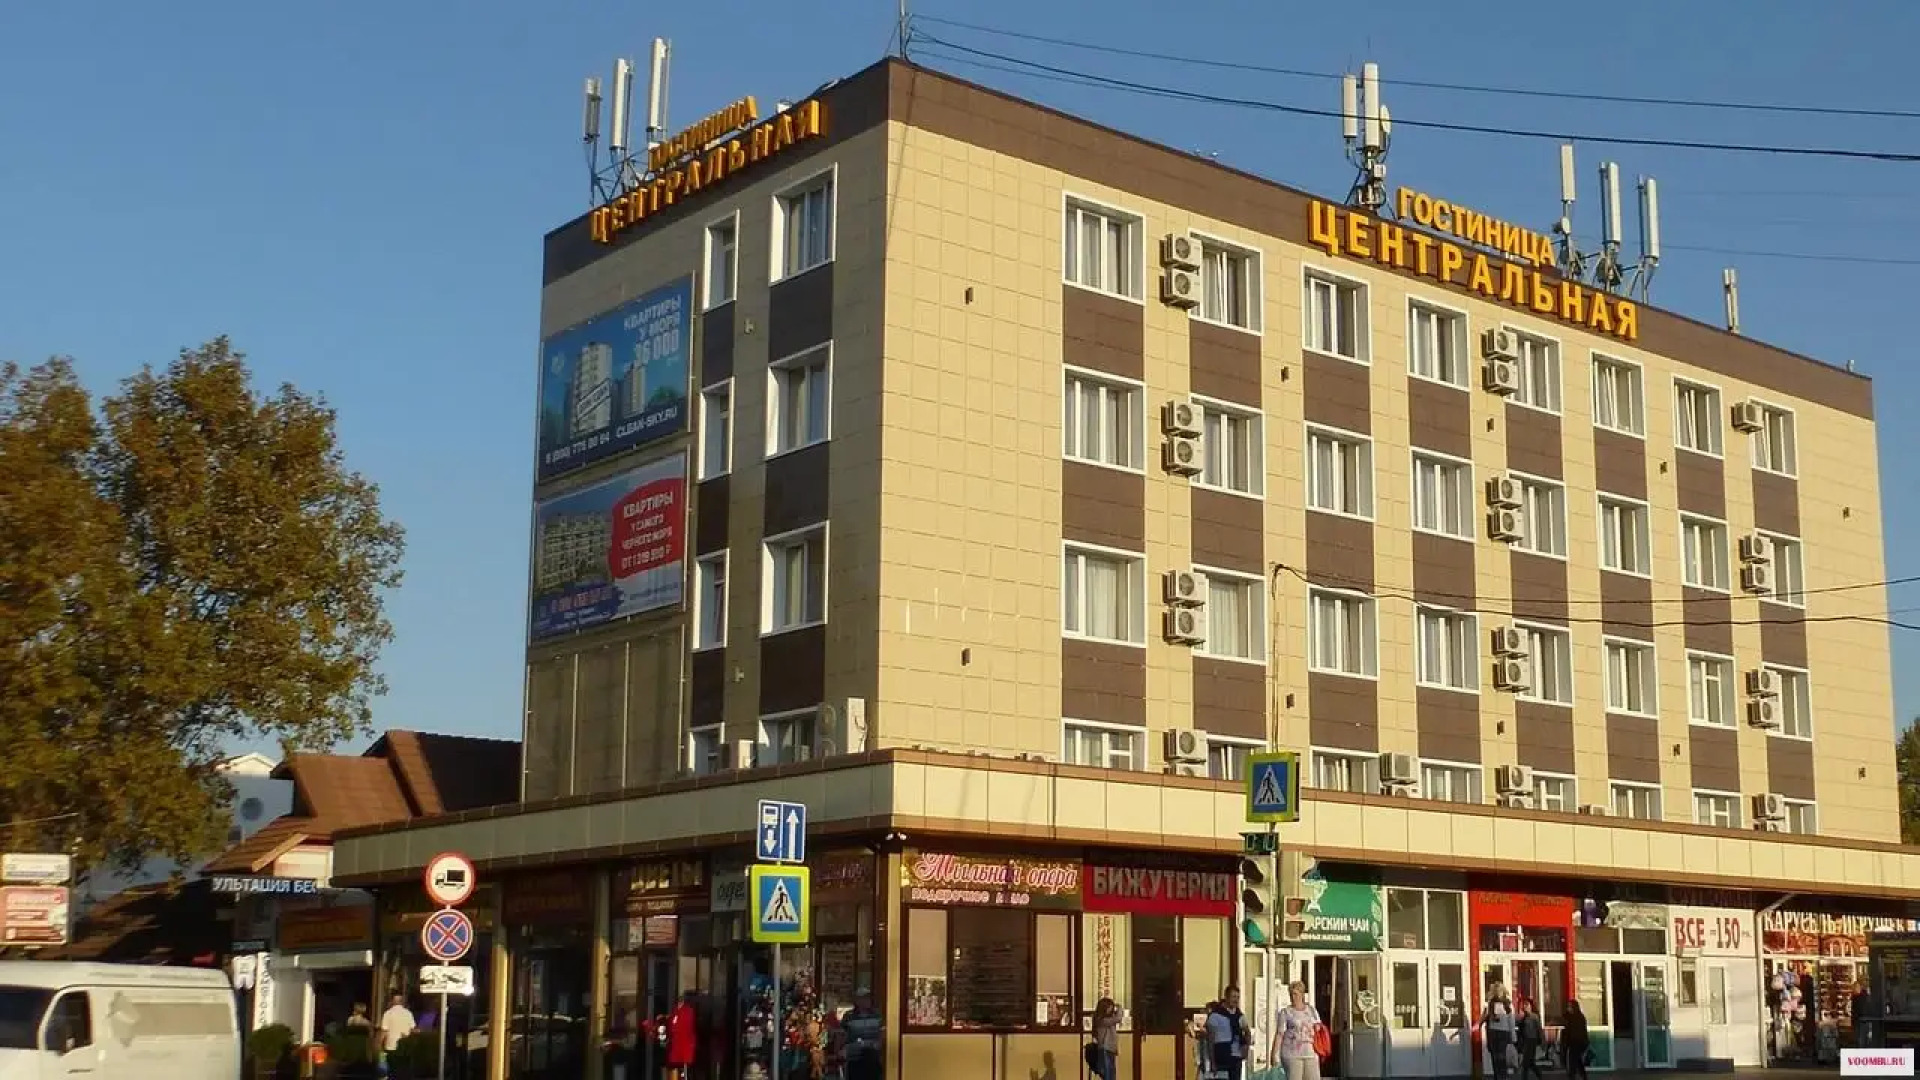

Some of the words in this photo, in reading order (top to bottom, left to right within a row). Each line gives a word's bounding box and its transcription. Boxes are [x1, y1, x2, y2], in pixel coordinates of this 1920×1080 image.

[591, 100, 827, 243] ЦЕНТРАЛЬНАЯ
[1397, 187, 1556, 267] ГОСТИНИЦА
[1308, 199, 1638, 339] ЦЕНТРАЛЬНАЯ
[624, 492, 672, 517] КВАРТИРЫ
[1094, 867, 1230, 900] БИЖУТЕРИЯ
[1674, 917, 1706, 949] ВСЕ
